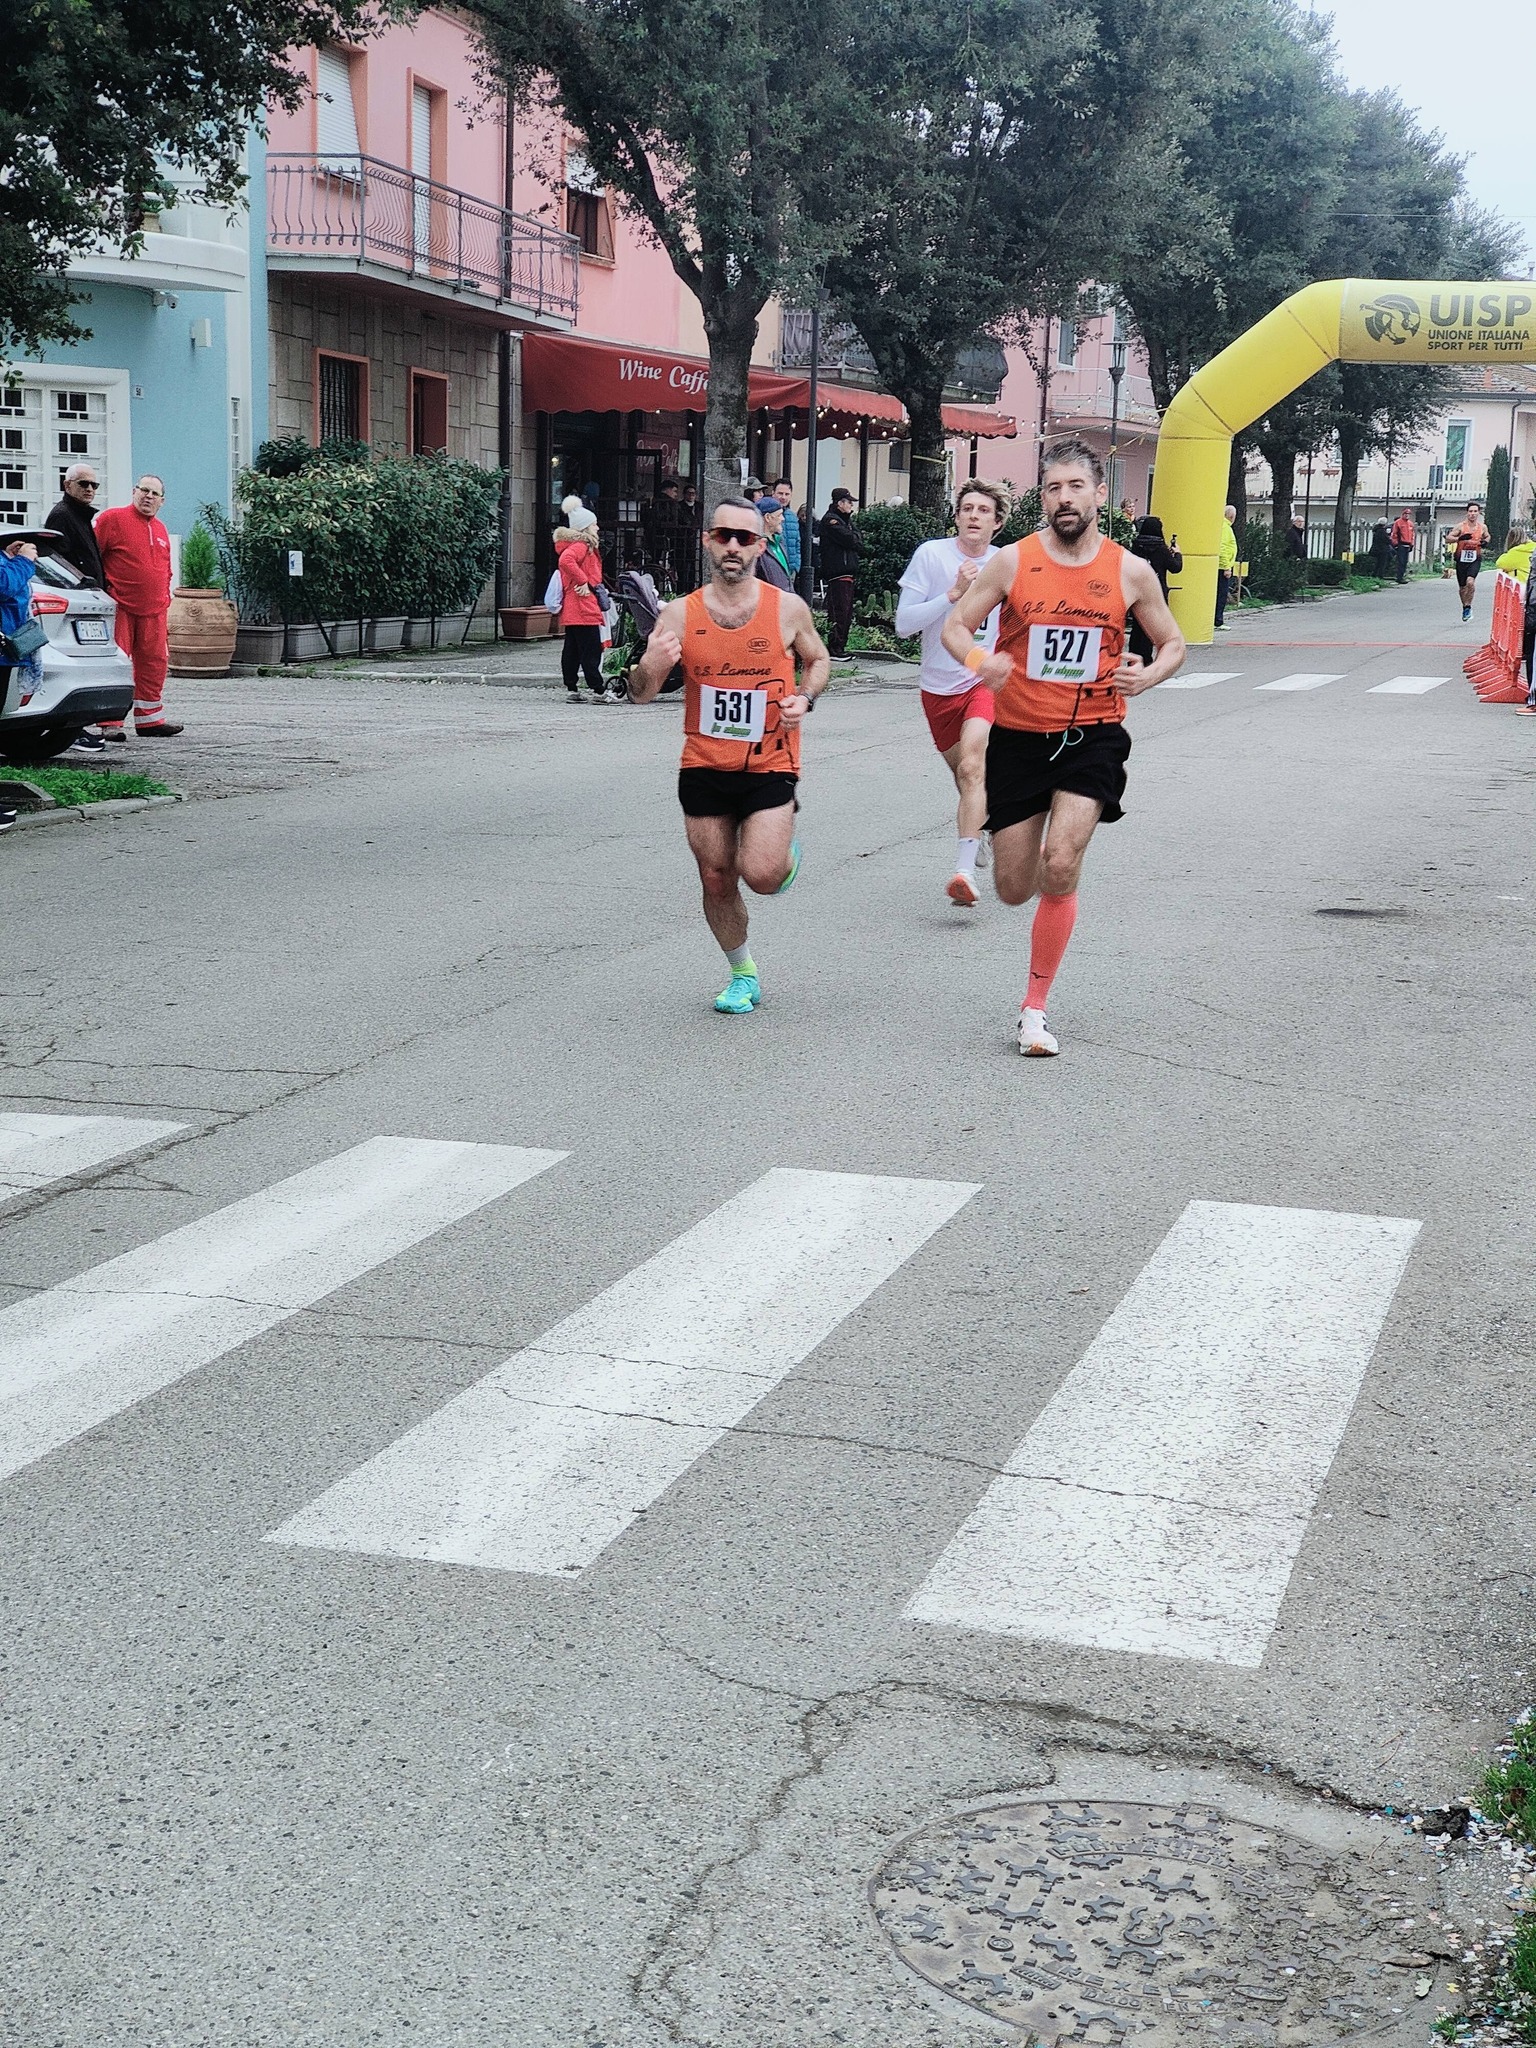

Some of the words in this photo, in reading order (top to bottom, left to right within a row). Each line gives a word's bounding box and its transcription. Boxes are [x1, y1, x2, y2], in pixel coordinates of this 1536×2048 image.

[1430, 294, 1532, 327] UISP
[1428, 329, 1473, 340] UNIONE
[1478, 330, 1530, 340] ITALIANA
[1427, 341, 1464, 351] SPORT
[1468, 342, 1488, 351] PER
[1494, 342, 1523, 351] TUTTI
[619, 358, 663, 381] Wine
[1050, 600, 1111, 622] Lamone
[1044, 628, 1089, 663] 527
[717, 662, 772, 677] Lamone
[714, 690, 752, 723] 531
